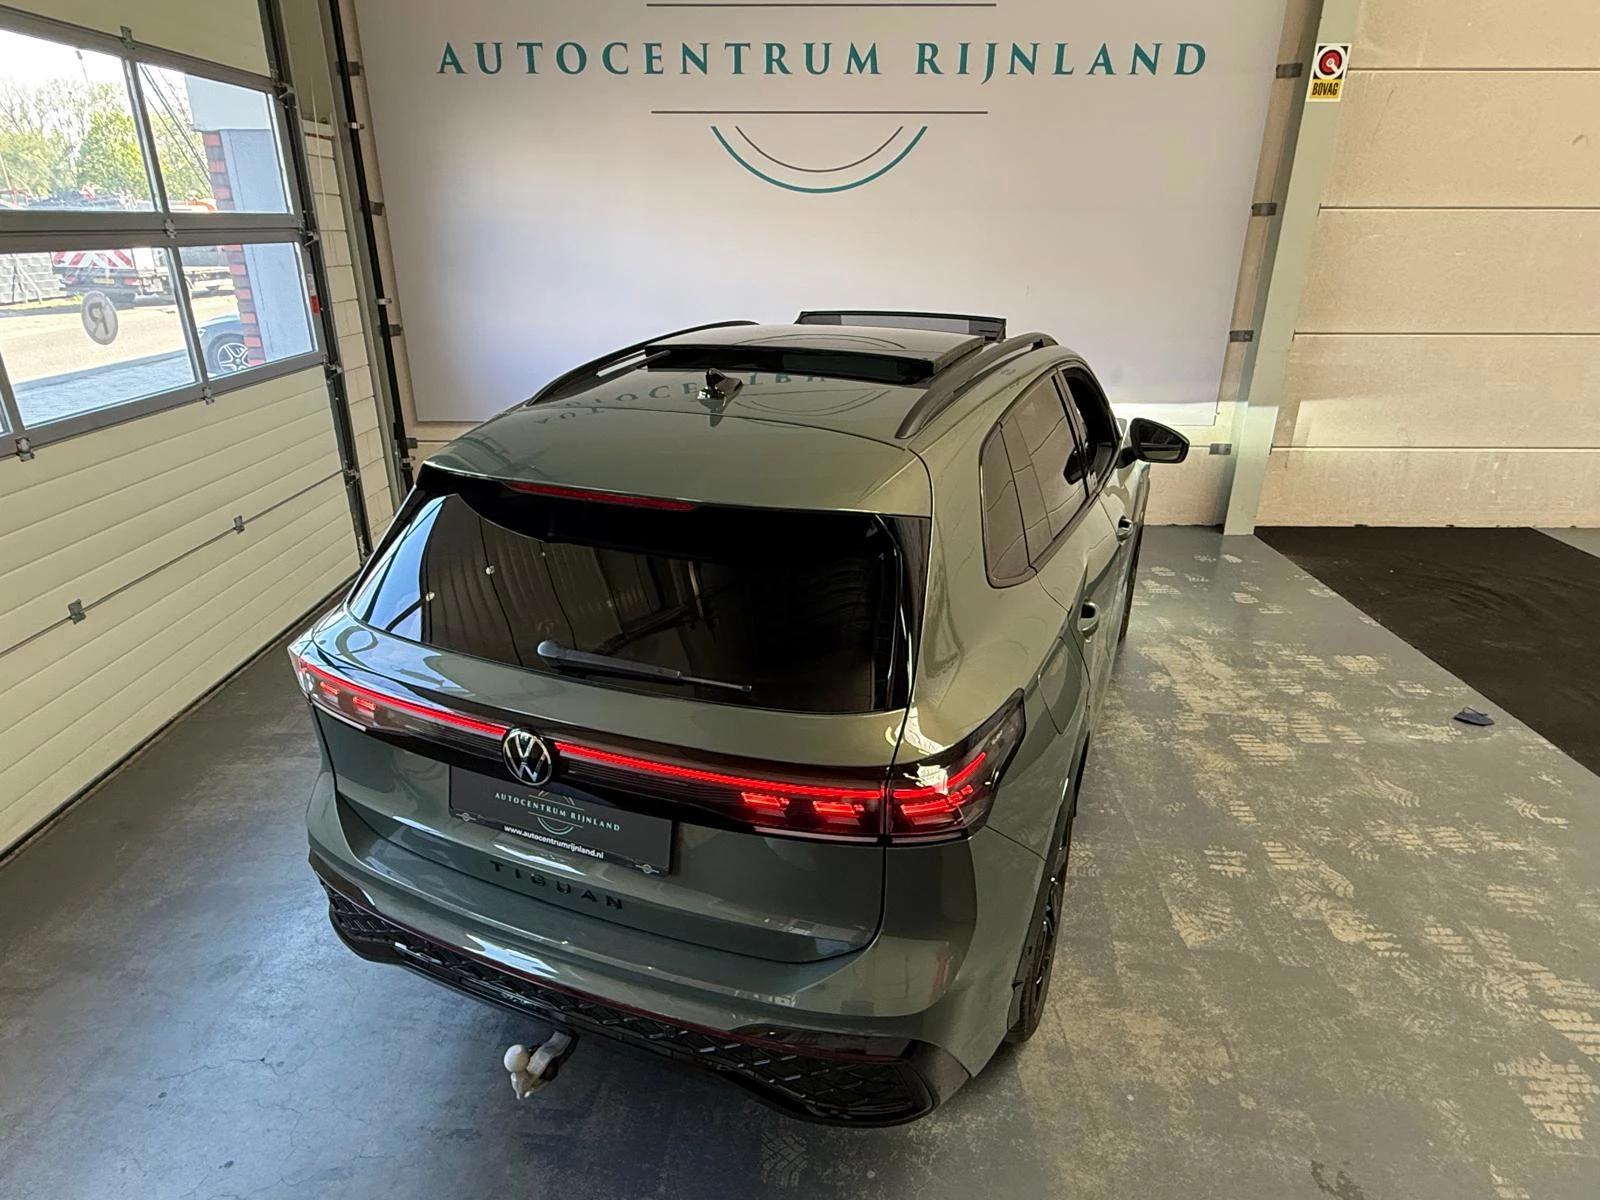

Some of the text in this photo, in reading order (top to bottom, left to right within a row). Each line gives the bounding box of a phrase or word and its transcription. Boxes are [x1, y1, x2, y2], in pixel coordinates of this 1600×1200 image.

[437, 42, 1208, 84] AUTOCENTRUM RIJNLAND
[1311, 82, 1340, 96] BOVAG
[494, 792, 620, 832] AUTOCENTRUM RIJNLAND
[503, 825, 604, 859] www.autocentrumrijnland.nl
[489, 860, 623, 909] TIGUAN
